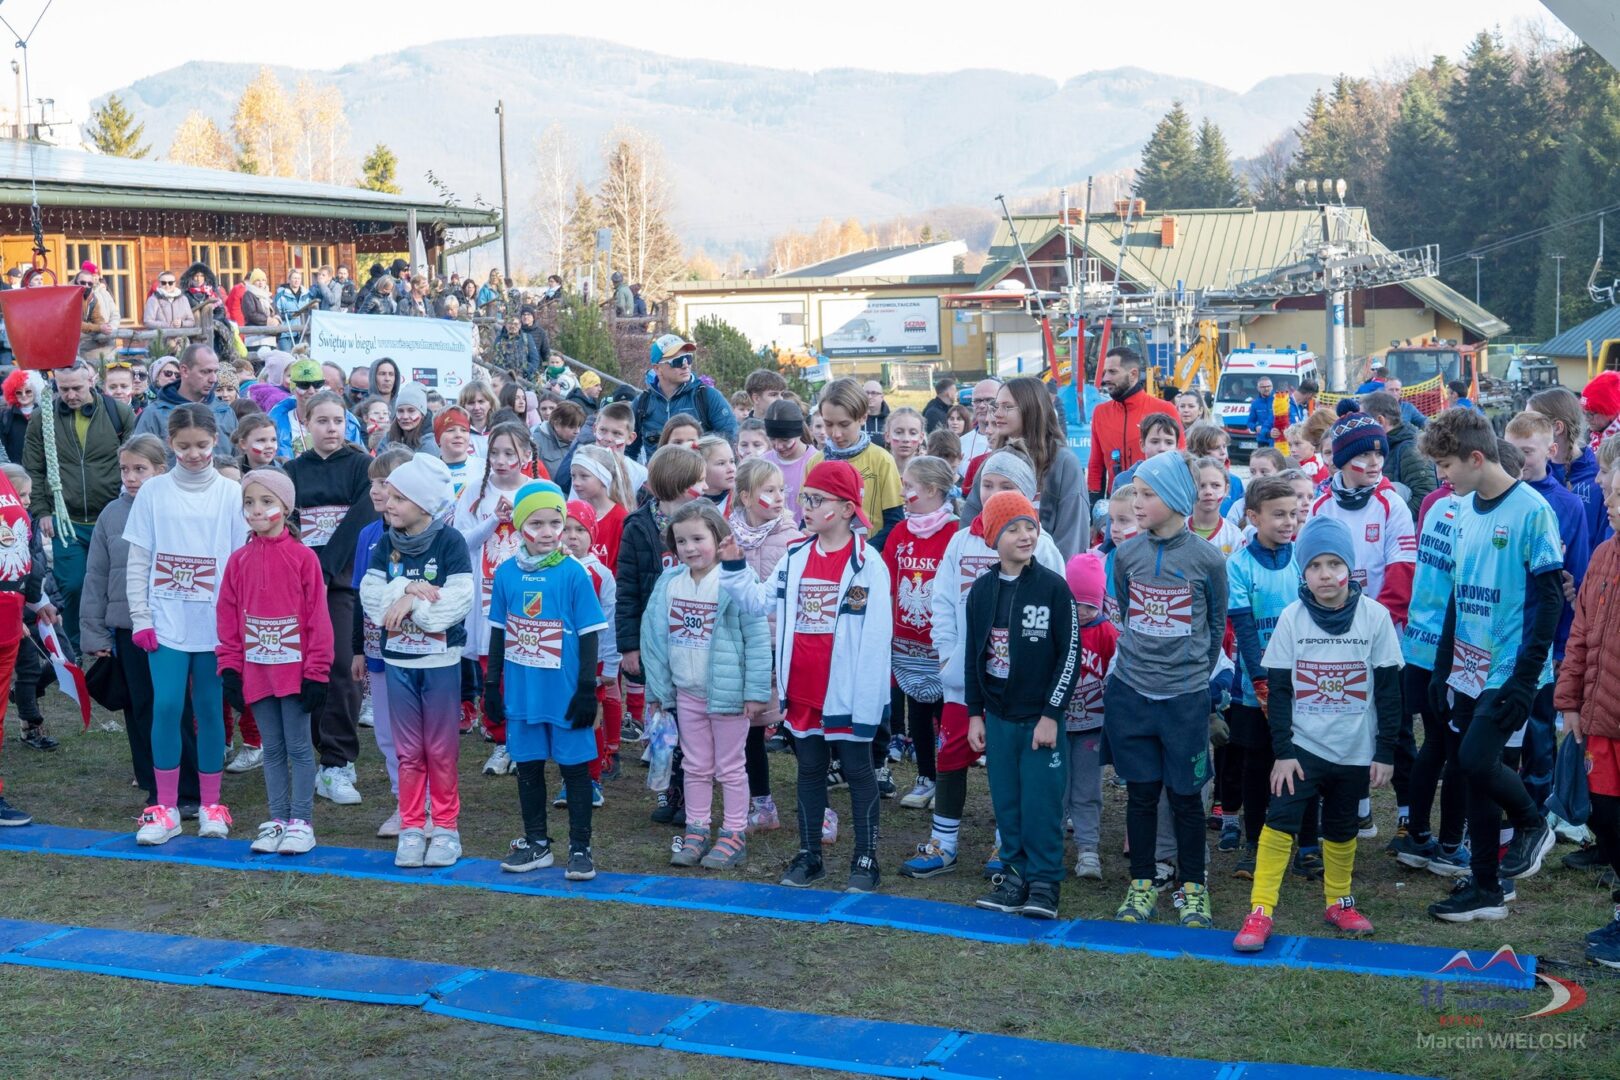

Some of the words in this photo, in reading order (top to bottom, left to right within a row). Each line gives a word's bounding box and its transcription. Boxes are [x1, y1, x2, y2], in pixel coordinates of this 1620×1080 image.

[318, 331, 346, 353] Świętuj
[355, 333, 377, 353] biegu!
[1434, 521, 1452, 537] MKL
[899, 557, 937, 570] POLSK
[175, 571, 192, 582] 477
[407, 568, 420, 577] MKL
[1146, 602, 1167, 616] 421
[684, 616, 702, 629] 330
[1022, 605, 1050, 629] 32
[261, 634, 278, 645] 475
[518, 632, 537, 646] 493
[994, 645, 1009, 657] 42
[1319, 662, 1367, 671] NIEPODLEGŁOŚCI
[1466, 659, 1477, 673] 325
[1320, 680, 1342, 693] 436
